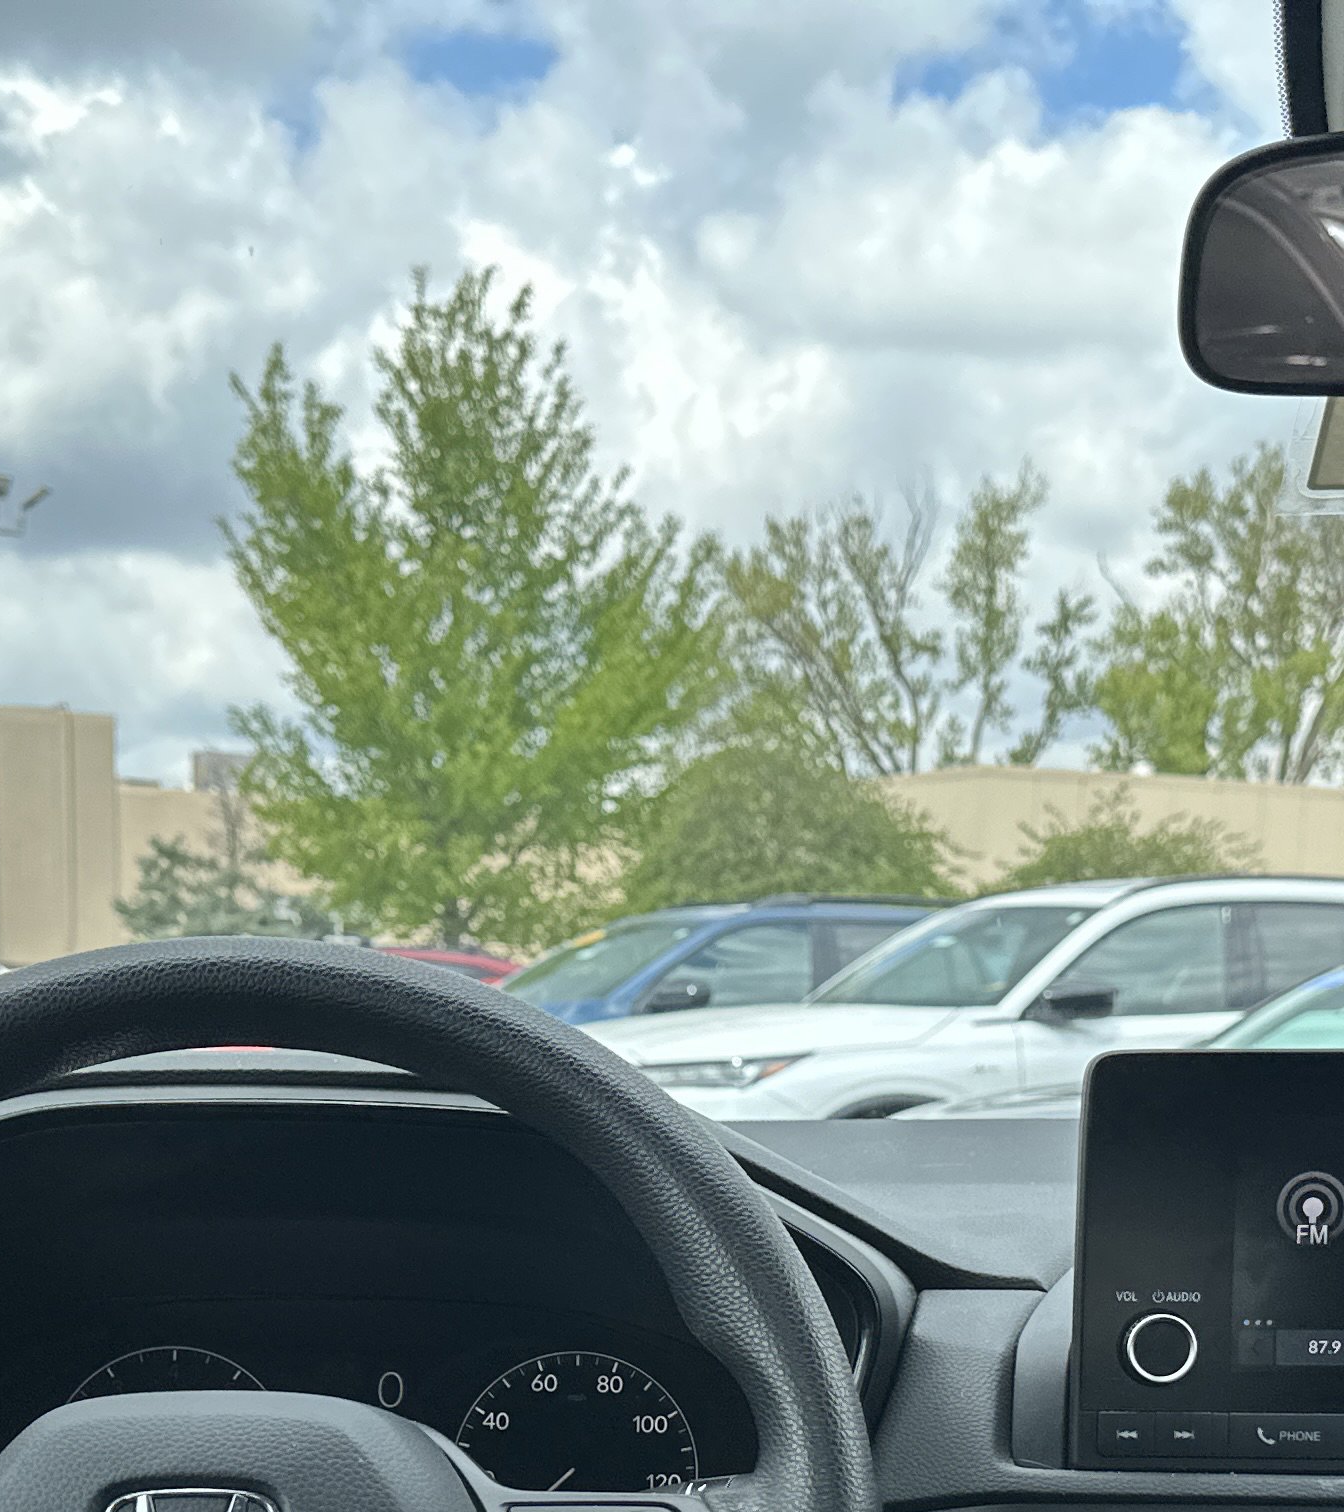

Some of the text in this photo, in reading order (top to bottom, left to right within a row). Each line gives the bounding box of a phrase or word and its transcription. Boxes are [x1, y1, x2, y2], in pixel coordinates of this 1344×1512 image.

[1295, 1224, 1329, 1246] FM
[1115, 1290, 1138, 1302] VOL
[1166, 1291, 1202, 1303] AUDIO
[1307, 1339, 1343, 1355] 87.9
[377, 1370, 404, 1409] 0
[530, 1373, 558, 1393] 60
[596, 1375, 624, 1394] 80
[481, 1411, 510, 1431] 40
[632, 1415, 668, 1434] 100
[1278, 1430, 1321, 1442] PHONE
